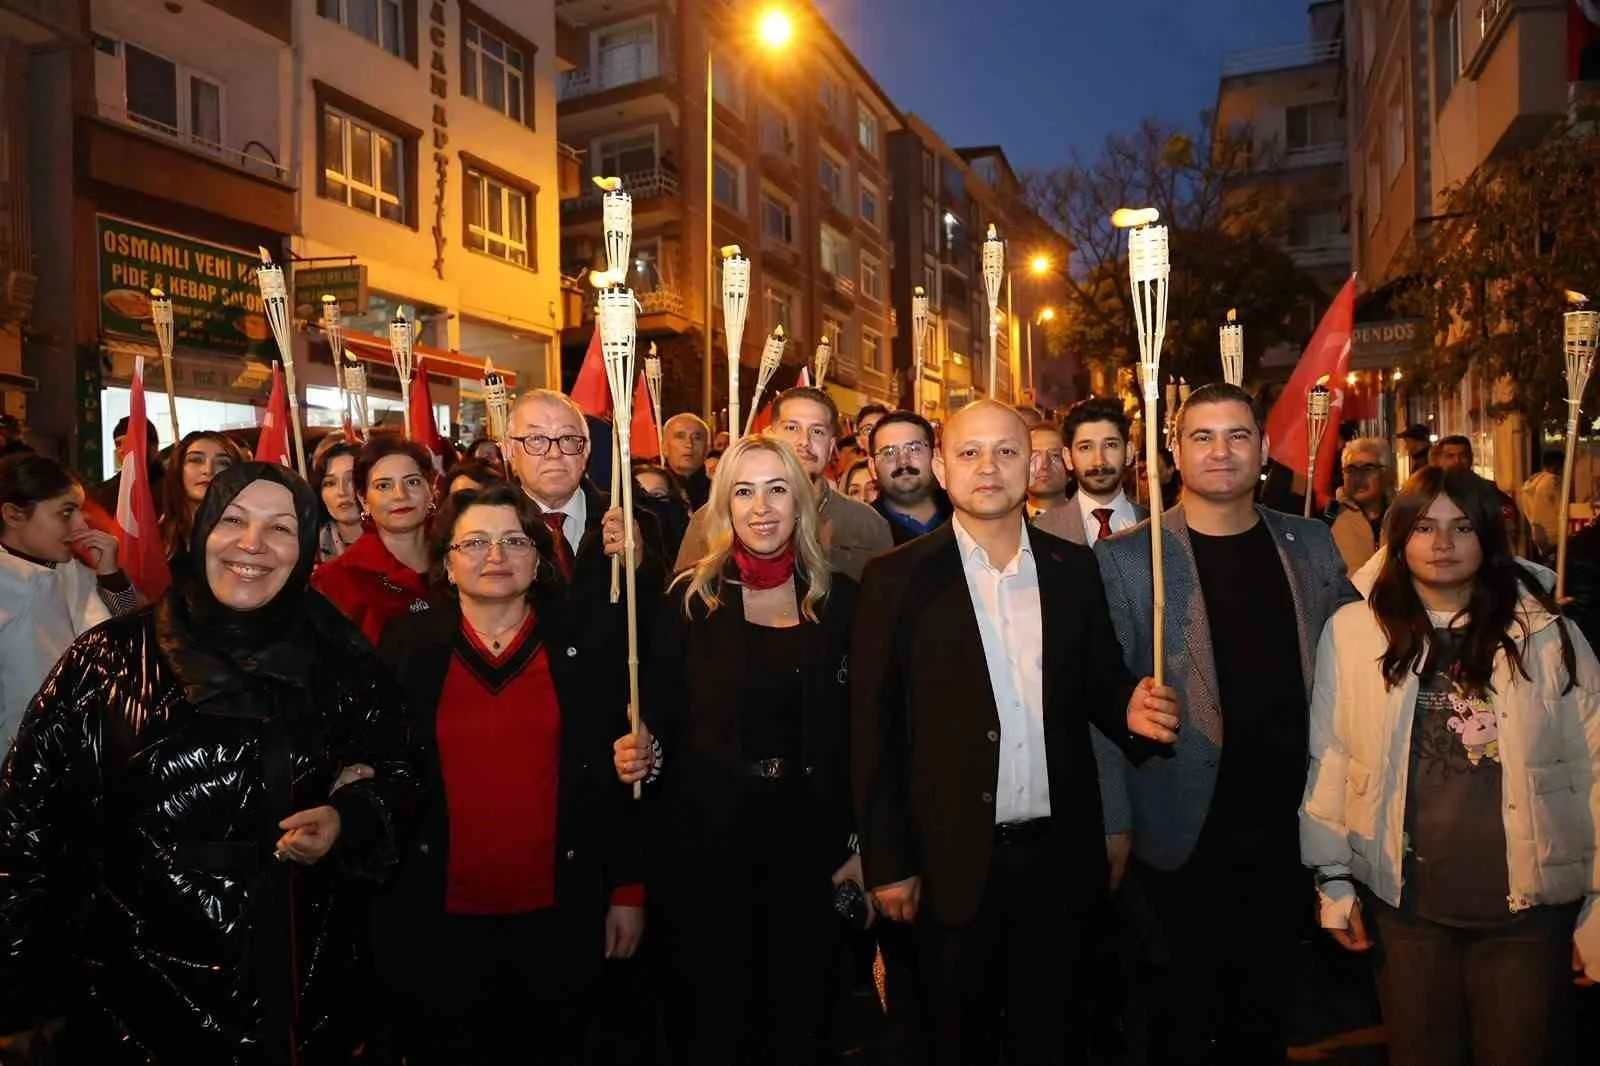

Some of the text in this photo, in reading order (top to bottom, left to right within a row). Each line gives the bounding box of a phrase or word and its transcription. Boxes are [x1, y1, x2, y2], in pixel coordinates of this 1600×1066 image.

[104, 230, 258, 287] OSMANLI YENİ KA
[112, 261, 149, 289] PİDE
[170, 276, 217, 304] KEBAP
[222, 288, 264, 313] SALON
